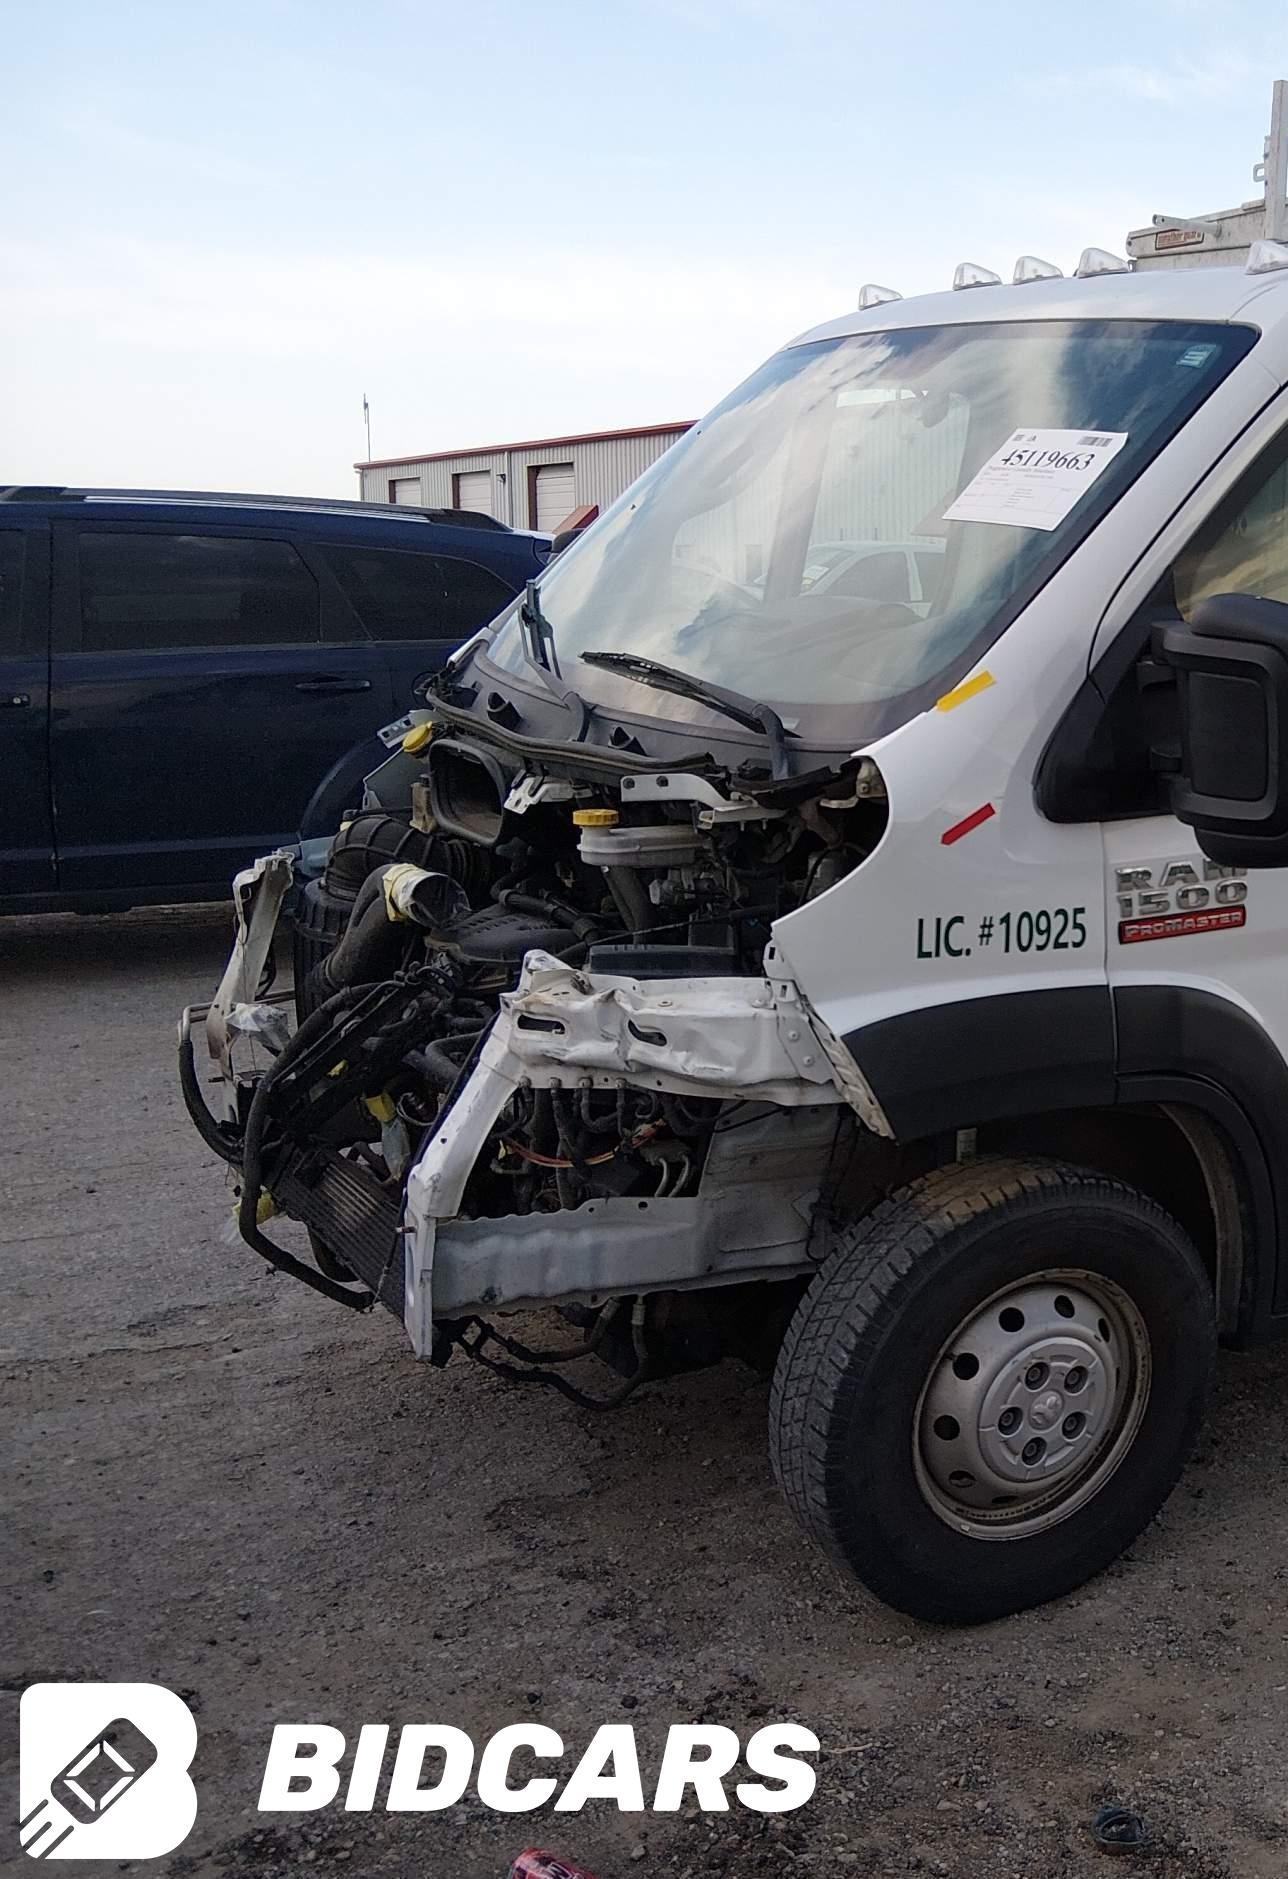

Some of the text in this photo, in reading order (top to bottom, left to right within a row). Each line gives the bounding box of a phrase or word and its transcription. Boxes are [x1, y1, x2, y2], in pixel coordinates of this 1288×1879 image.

[1001, 449, 1095, 470] 45119663
[1117, 880, 1248, 918] 1500
[917, 907, 1087, 958] LIC. #10925
